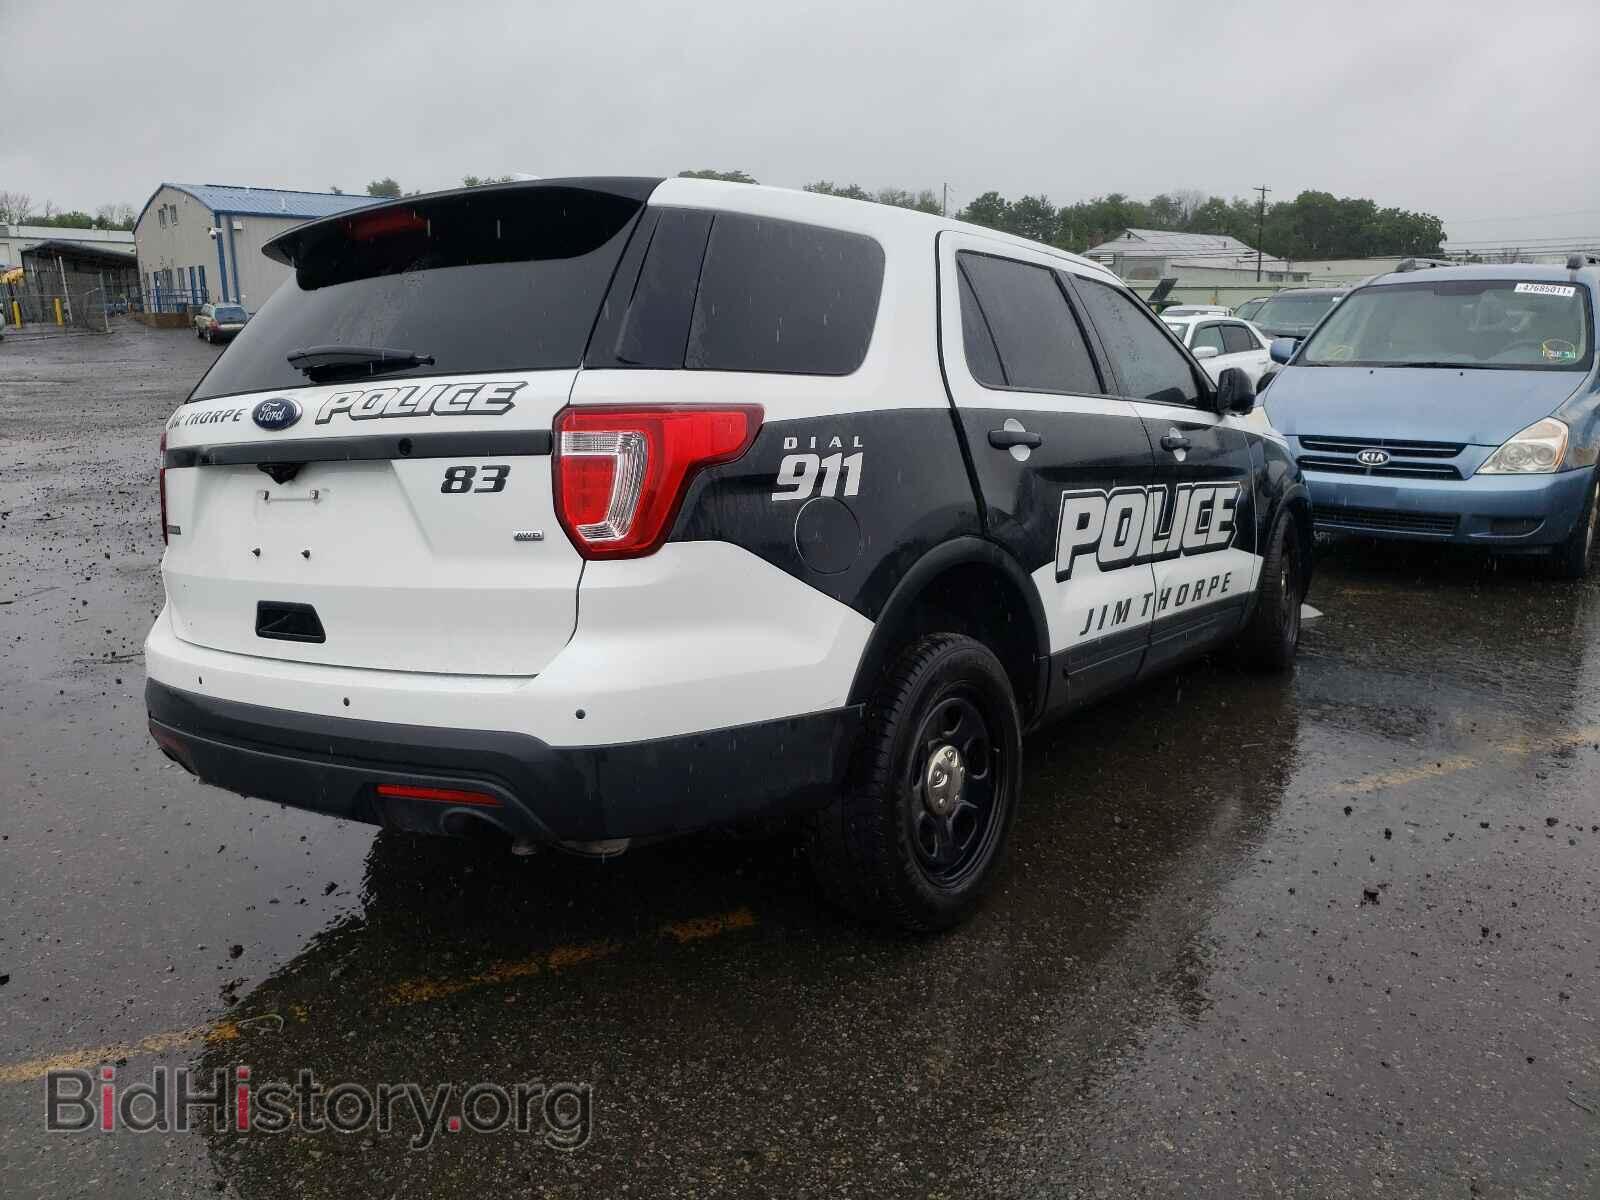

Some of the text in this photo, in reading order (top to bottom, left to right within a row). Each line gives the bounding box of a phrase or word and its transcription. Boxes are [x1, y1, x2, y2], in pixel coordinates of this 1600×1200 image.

[184, 408, 248, 425] THORPE
[258, 402, 287, 421] Ford
[315, 381, 528, 425] POLICE
[783, 435, 864, 450] DIAL
[1361, 452, 1384, 462] KIA
[440, 464, 511, 493] 83
[771, 452, 864, 501] 911
[1055, 481, 1242, 583] POLICE
[1079, 571, 1233, 636] JIM THORPE
